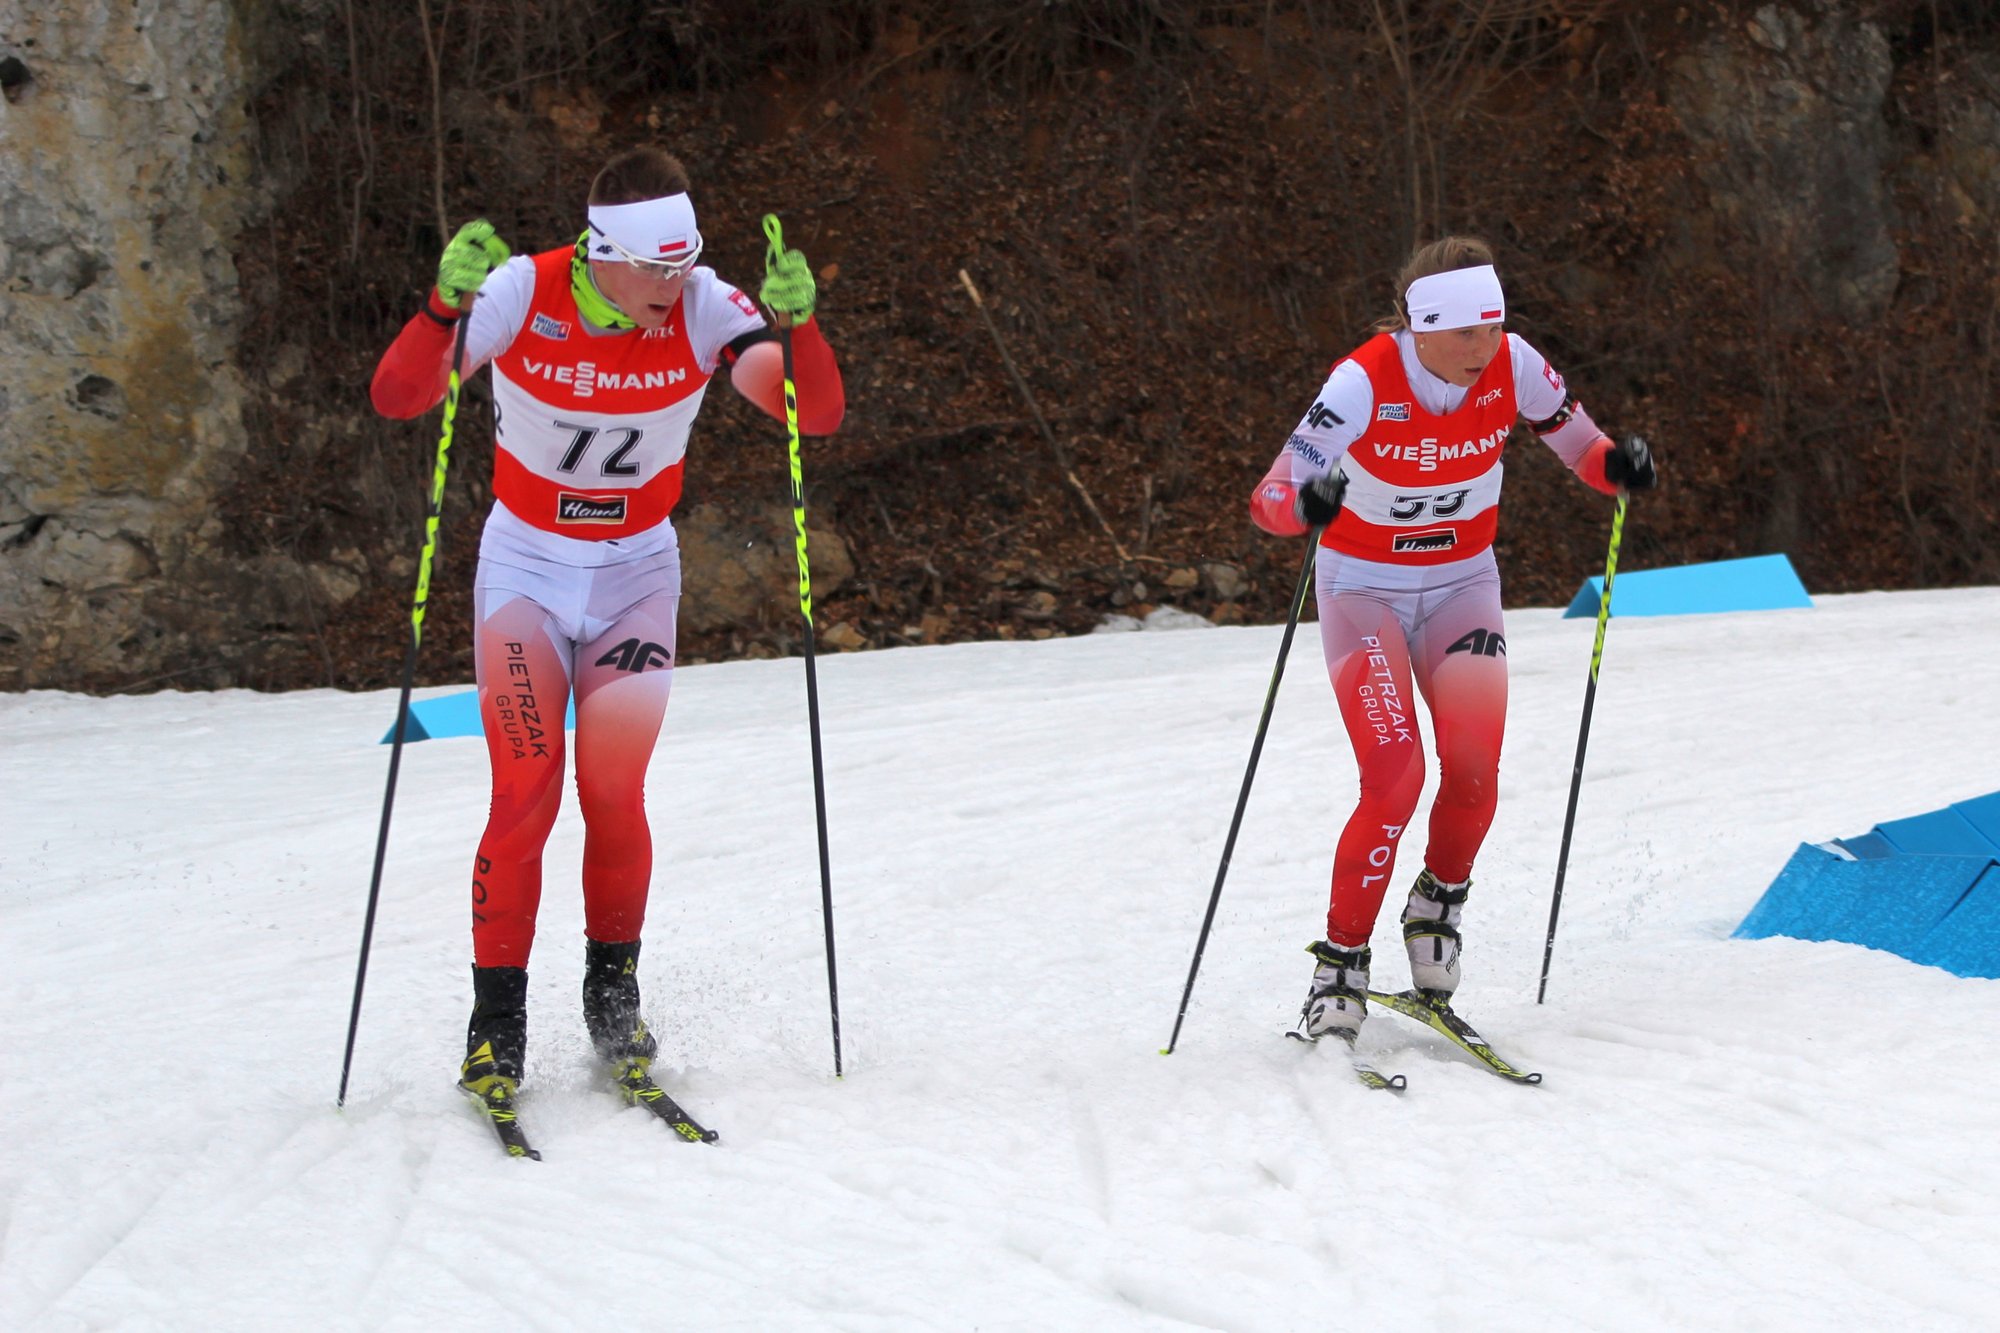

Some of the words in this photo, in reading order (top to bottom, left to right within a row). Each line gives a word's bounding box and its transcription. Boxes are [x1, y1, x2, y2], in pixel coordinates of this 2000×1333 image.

[1423, 312, 1440, 325] 4F
[522, 356, 686, 397] VIESSMANN
[553, 420, 643, 477] 72
[1373, 424, 1510, 472] VIESSMANN
[794, 507, 813, 628] WAY
[594, 638, 671, 674] 4F
[504, 642, 549, 758] PIETRZAK
[1359, 685, 1391, 745] GRUPA
[1361, 636, 1413, 742] PIETRZAK
[496, 695, 526, 759] GRUPA
[1362, 824, 1402, 888] POL
